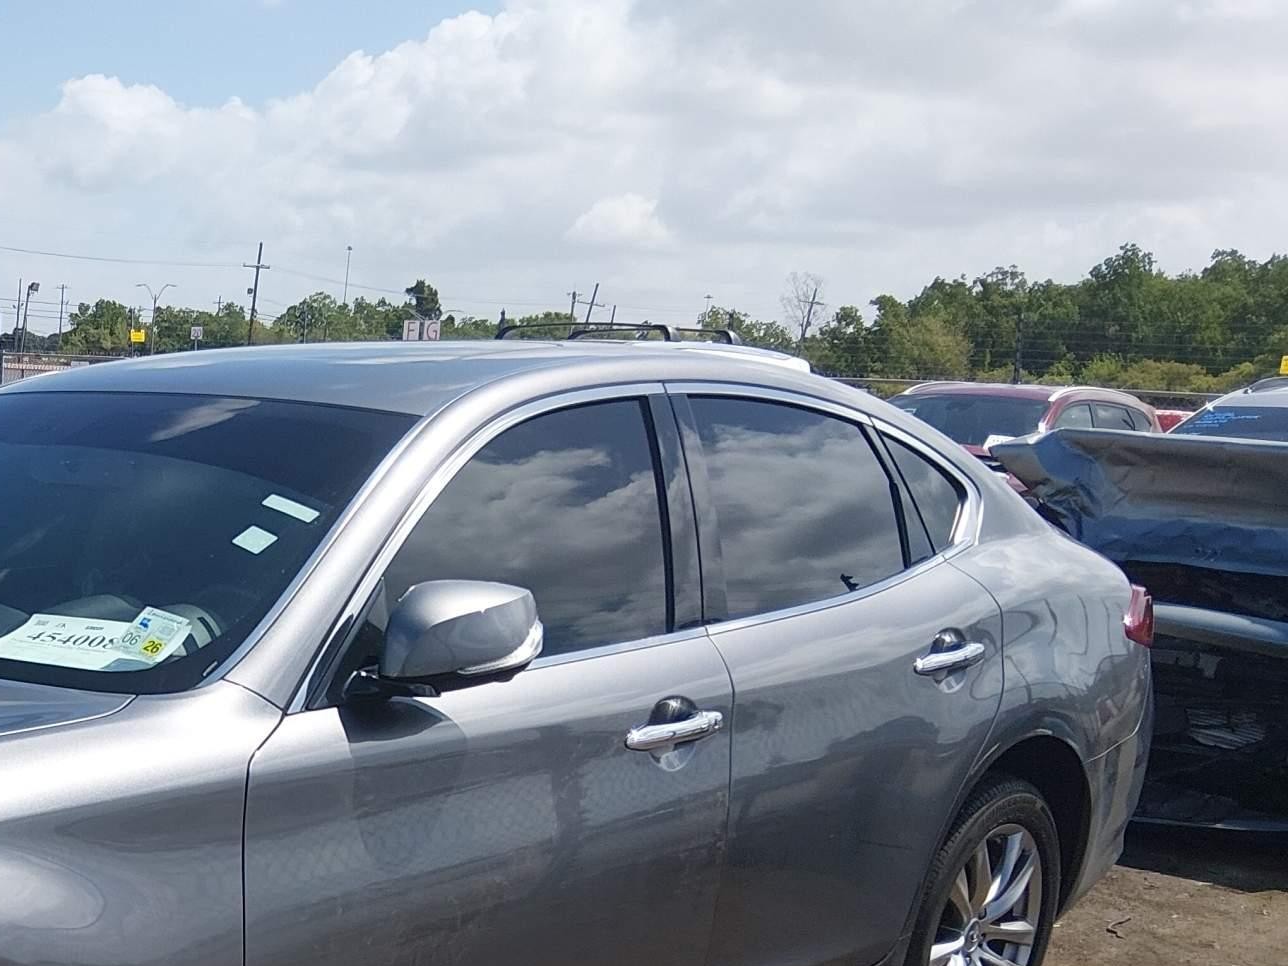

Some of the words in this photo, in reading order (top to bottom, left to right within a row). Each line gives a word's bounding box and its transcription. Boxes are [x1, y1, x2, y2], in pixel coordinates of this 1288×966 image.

[406, 321, 417, 340] F
[426, 321, 438, 340] G
[122, 632, 141, 646] 06
[143, 640, 162, 654] 26
